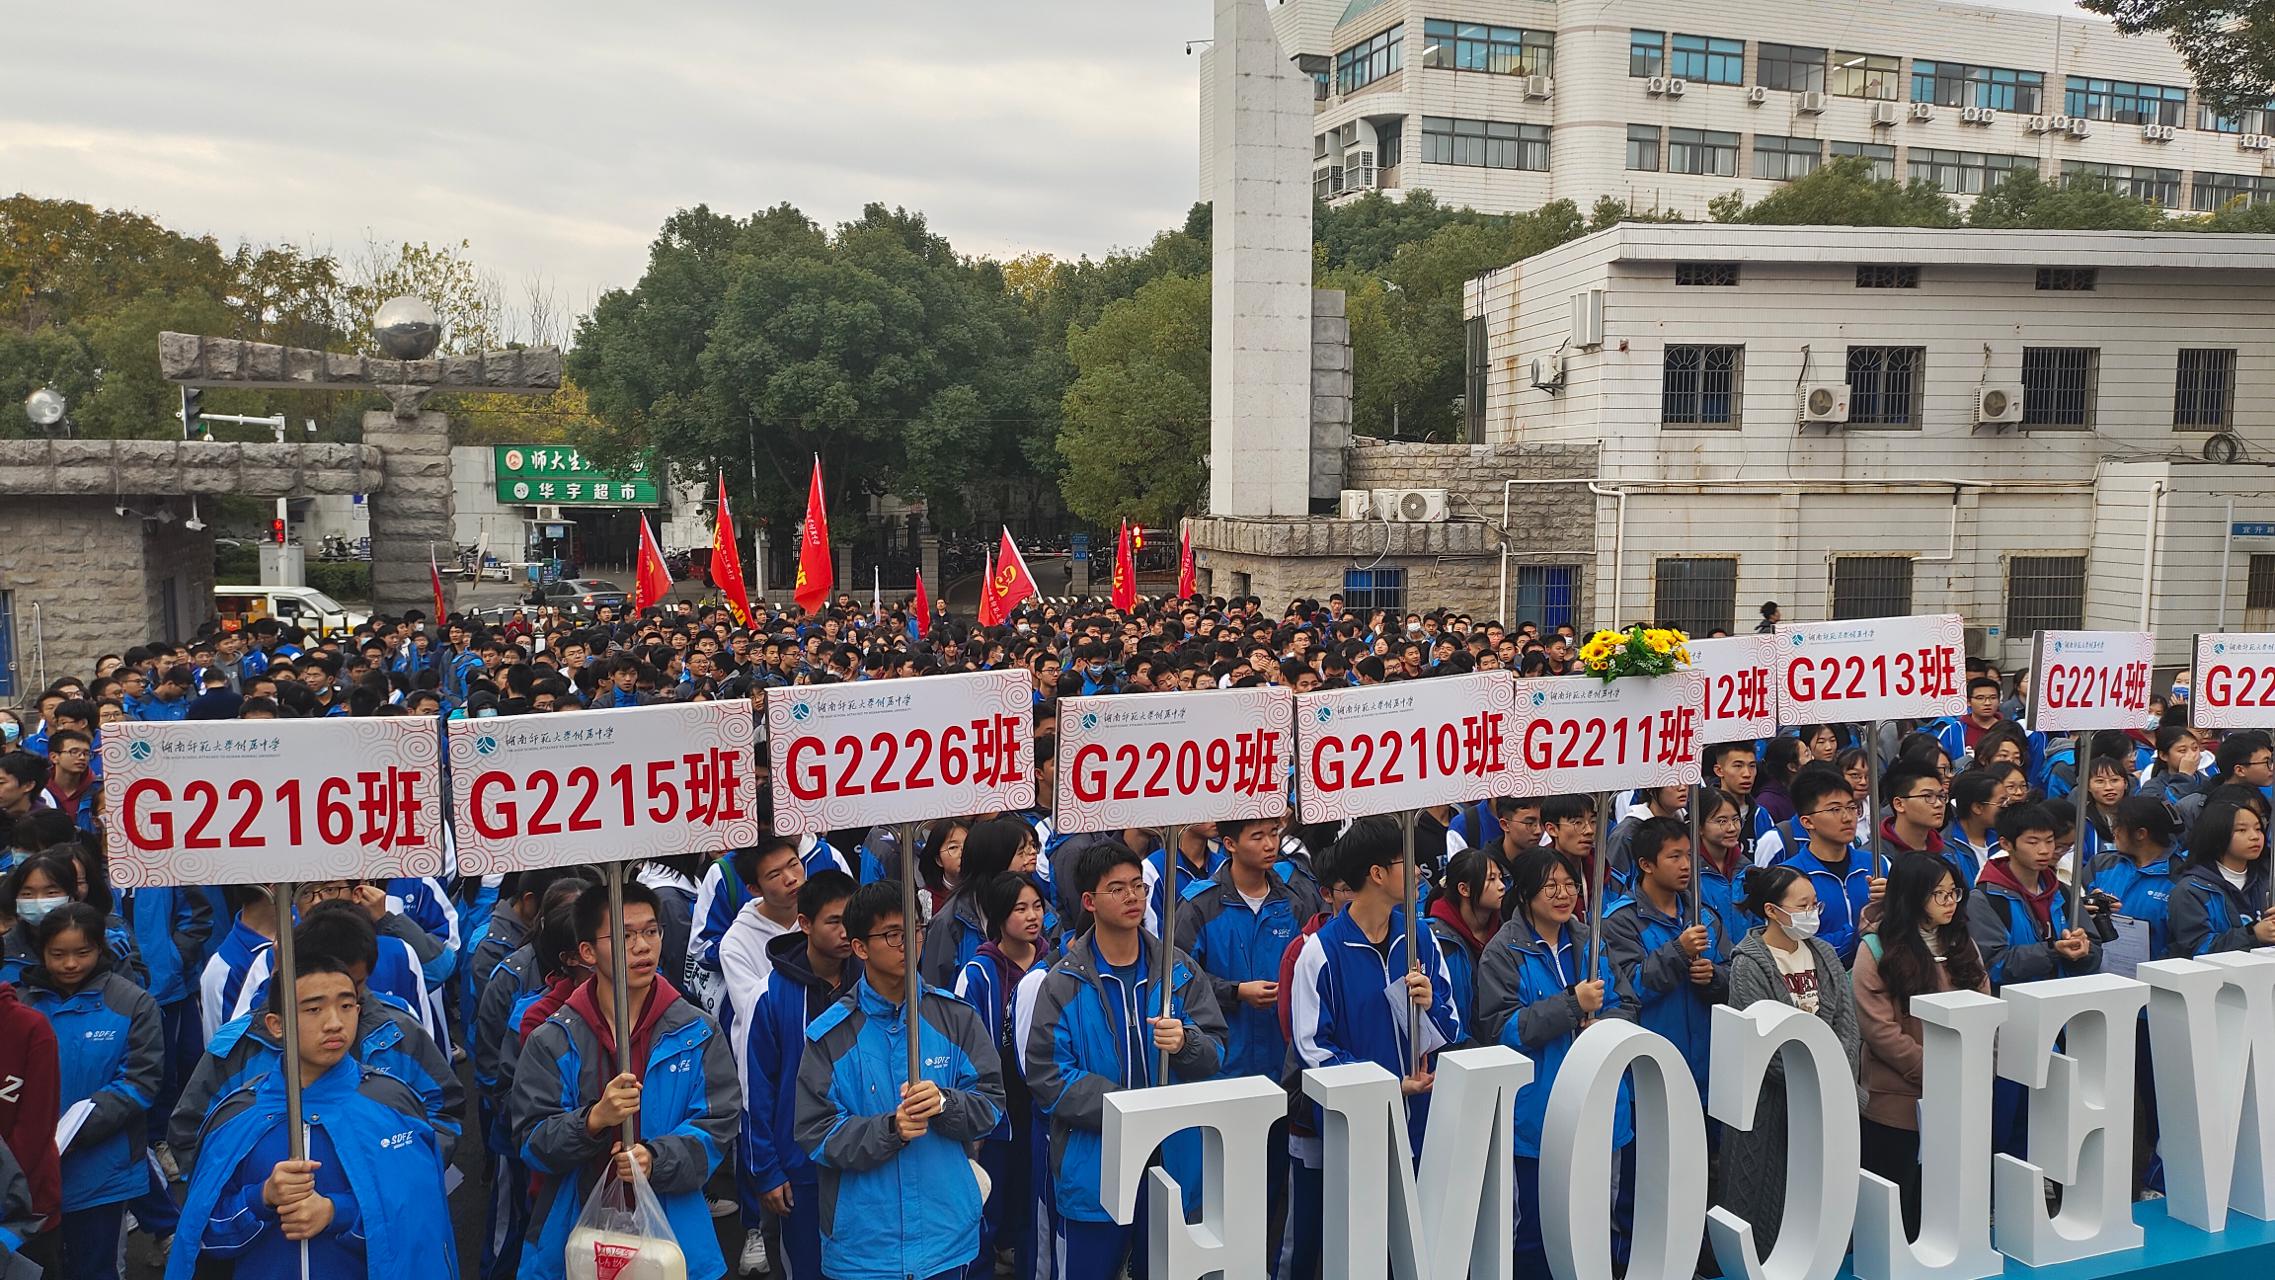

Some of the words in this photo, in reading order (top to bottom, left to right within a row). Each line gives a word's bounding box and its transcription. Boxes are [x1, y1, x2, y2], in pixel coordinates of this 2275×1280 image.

[538, 482, 636, 501] 华宇超市
[1787, 645, 1957, 703] G2213班
[2047, 660, 2148, 712] G2214班
[785, 713, 1023, 801] G2226班
[1071, 728, 1280, 803] G2209班
[1311, 710, 1506, 793] G2210班
[1523, 705, 1695, 771] G2211班
[122, 766, 426, 852] G2216班
[470, 746, 746, 840] G2215班
[390, 1130, 414, 1145] SDFZ
